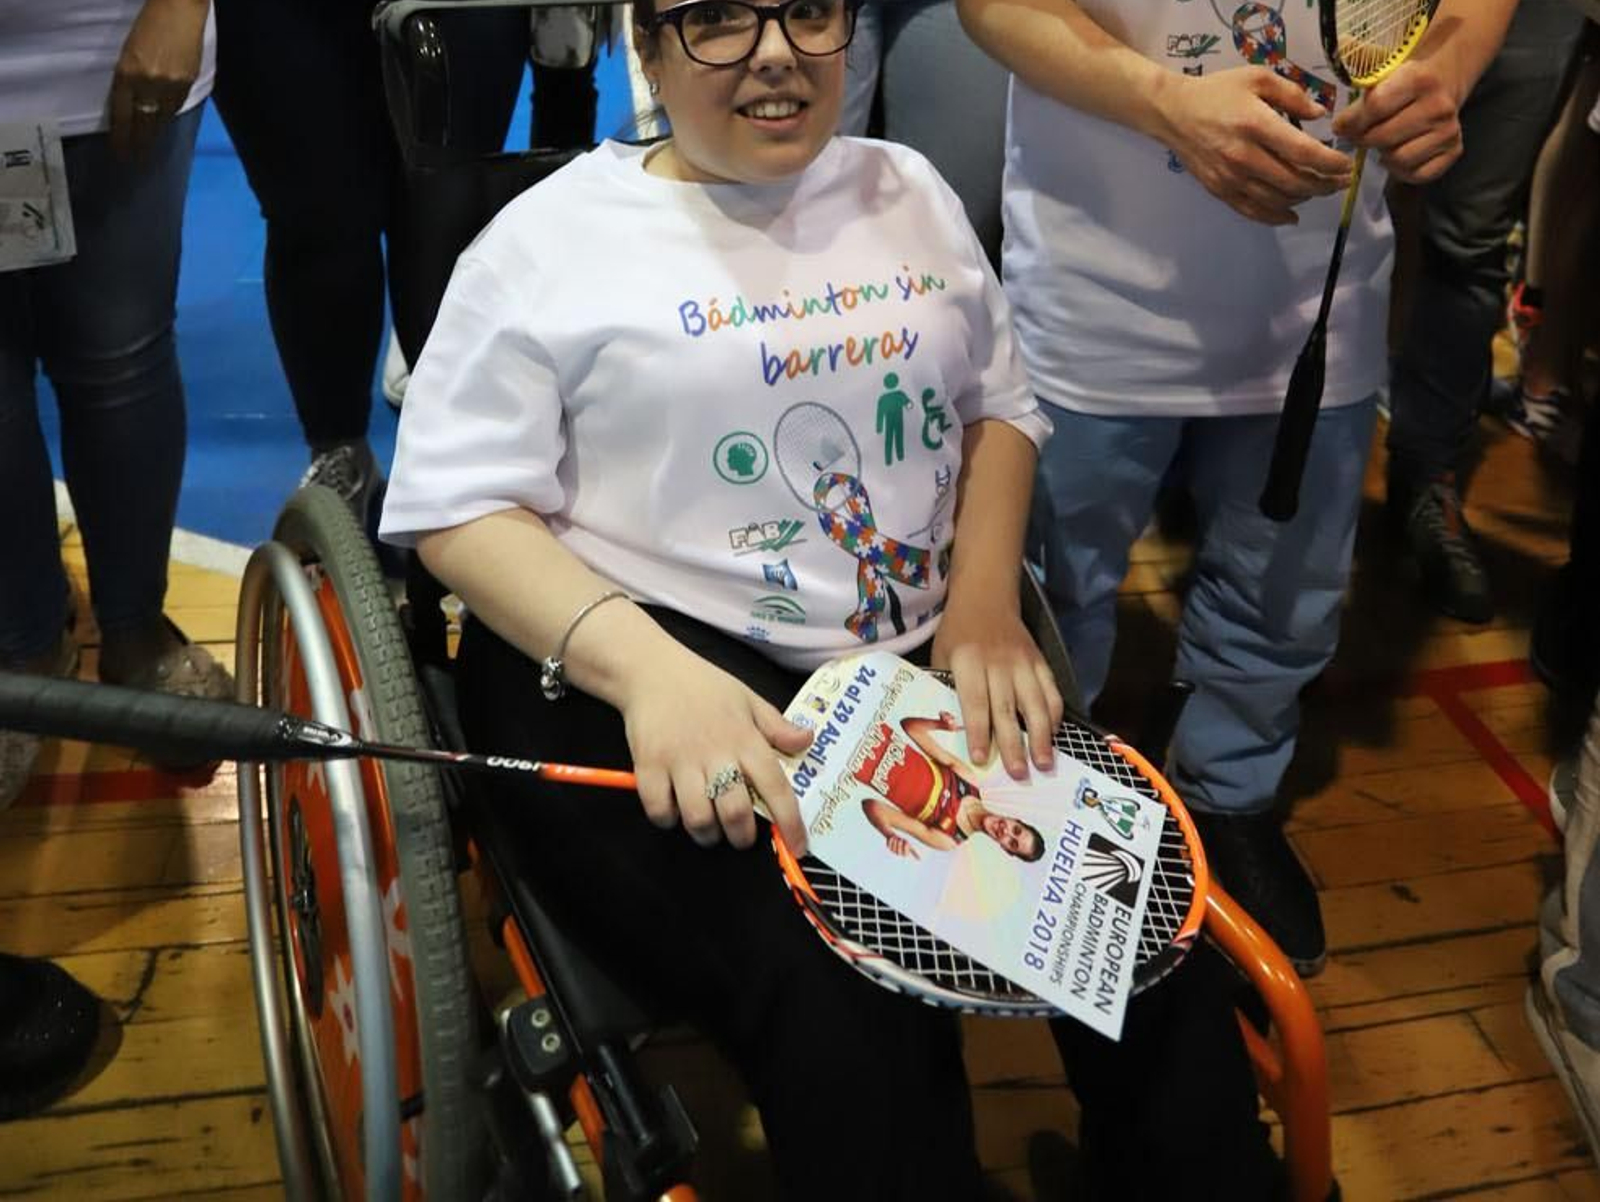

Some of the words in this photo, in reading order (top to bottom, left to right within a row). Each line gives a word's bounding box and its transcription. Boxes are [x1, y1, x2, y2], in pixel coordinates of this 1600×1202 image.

[679, 282, 888, 337] Bádminton
[896, 265, 945, 300] sin
[760, 327, 919, 386] barreras
[845, 684, 862, 704] al
[855, 665, 877, 687] 24
[832, 700, 855, 725] 29
[807, 721, 841, 766] Abril
[792, 762, 818, 798] 201
[1043, 819, 1084, 904] HUELVA
[1024, 907, 1057, 971] 2018
[1050, 882, 1087, 986] CHAMPIONSHIPS
[1071, 892, 1108, 1000] BADMINTON
[1094, 904, 1132, 1015] EUROPEAN
